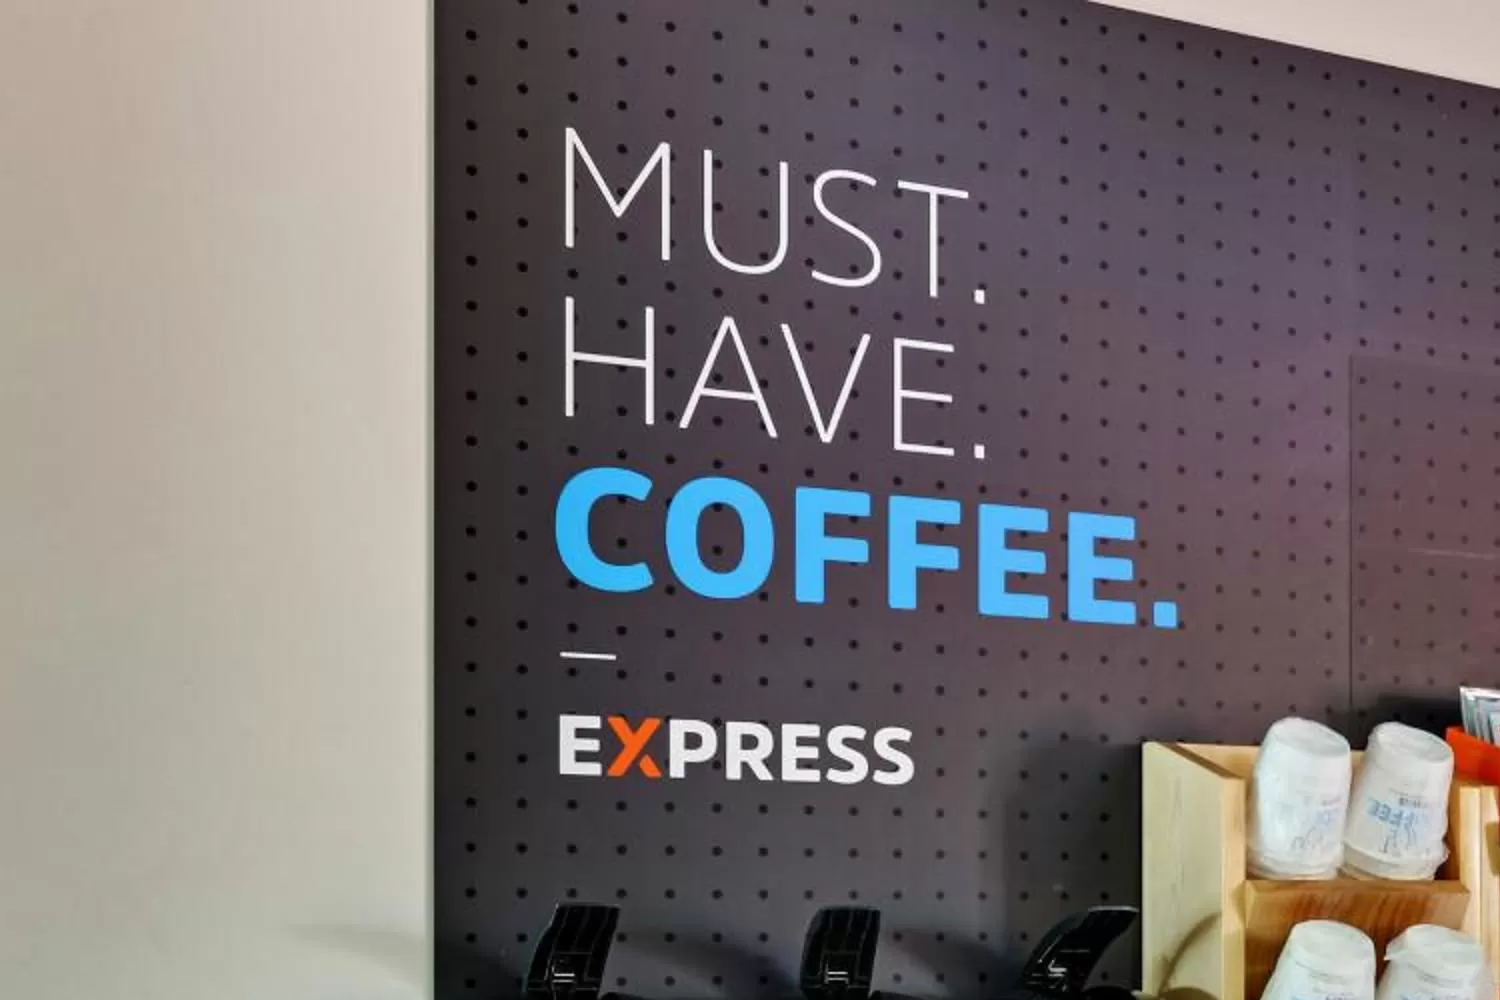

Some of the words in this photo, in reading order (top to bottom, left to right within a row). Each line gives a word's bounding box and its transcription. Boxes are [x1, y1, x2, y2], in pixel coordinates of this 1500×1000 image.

[565, 126, 986, 305] MUST.
[565, 295, 986, 460] HAVE.
[554, 466, 1178, 629] COFFEE.
[558, 714, 916, 785] EXPRESS
